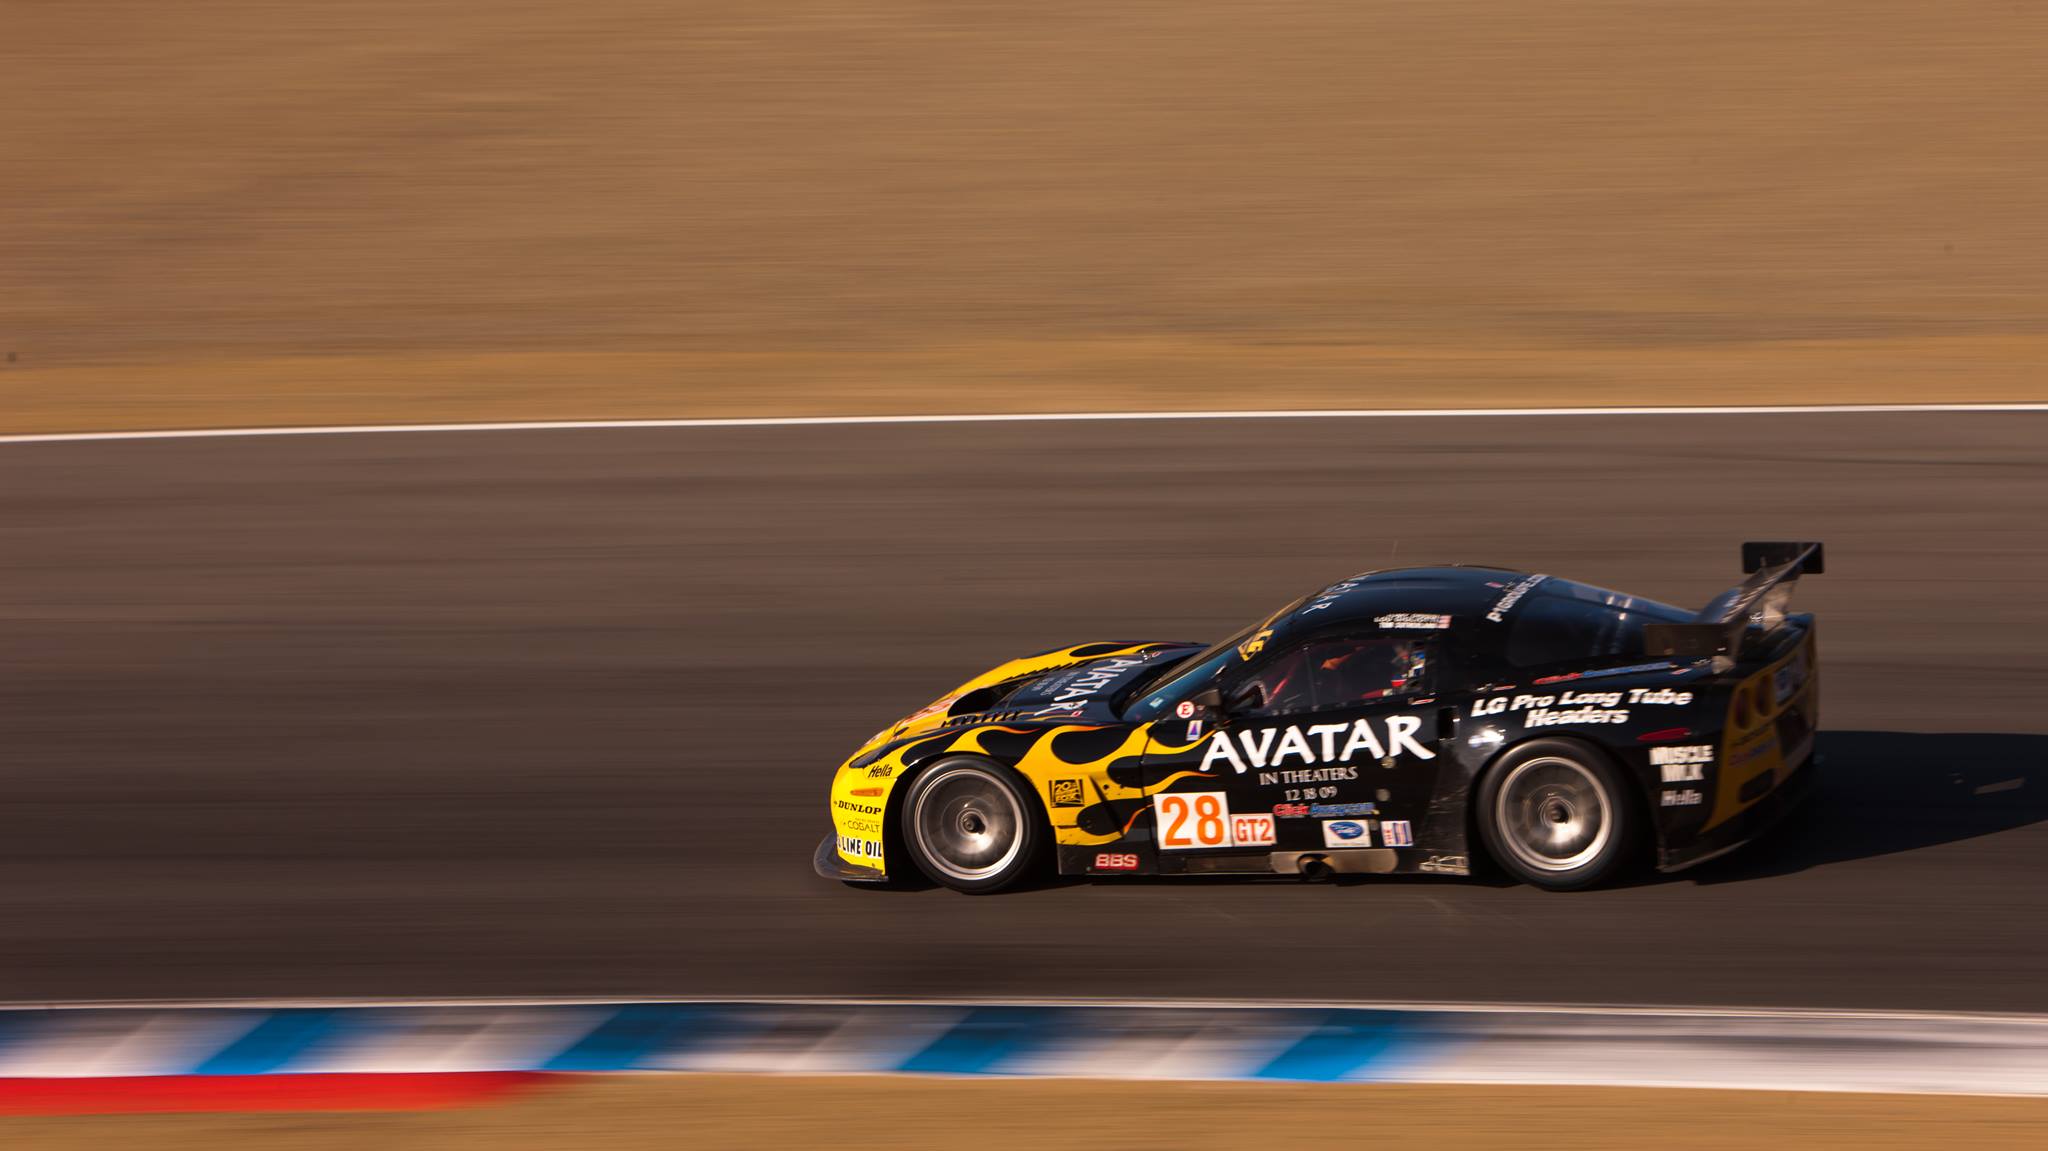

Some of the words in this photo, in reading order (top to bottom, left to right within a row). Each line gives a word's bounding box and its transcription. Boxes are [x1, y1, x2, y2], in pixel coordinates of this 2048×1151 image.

[1033, 659, 1143, 716] AVATAR
[1470, 698, 1508, 717] LG
[1509, 695, 1555, 711] Pro
[1557, 691, 1624, 708] Long
[1628, 688, 1693, 705] Tube
[1524, 706, 1631, 728] Headers
[1199, 715, 1437, 774] AVATAR
[867, 763, 893, 778] Hella
[1259, 771, 1278, 786] IN
[1280, 766, 1359, 784] THEATERS
[1285, 789, 1301, 801] 12
[1319, 785, 1337, 799] 09
[838, 800, 882, 815] DUNLOP
[847, 820, 880, 833] COBALT
[1161, 795, 1224, 846] 28
[1235, 818, 1272, 843] GT2
[842, 836, 861, 855] LINE
[865, 840, 882, 857] OIL
[1095, 854, 1138, 868] BBS
